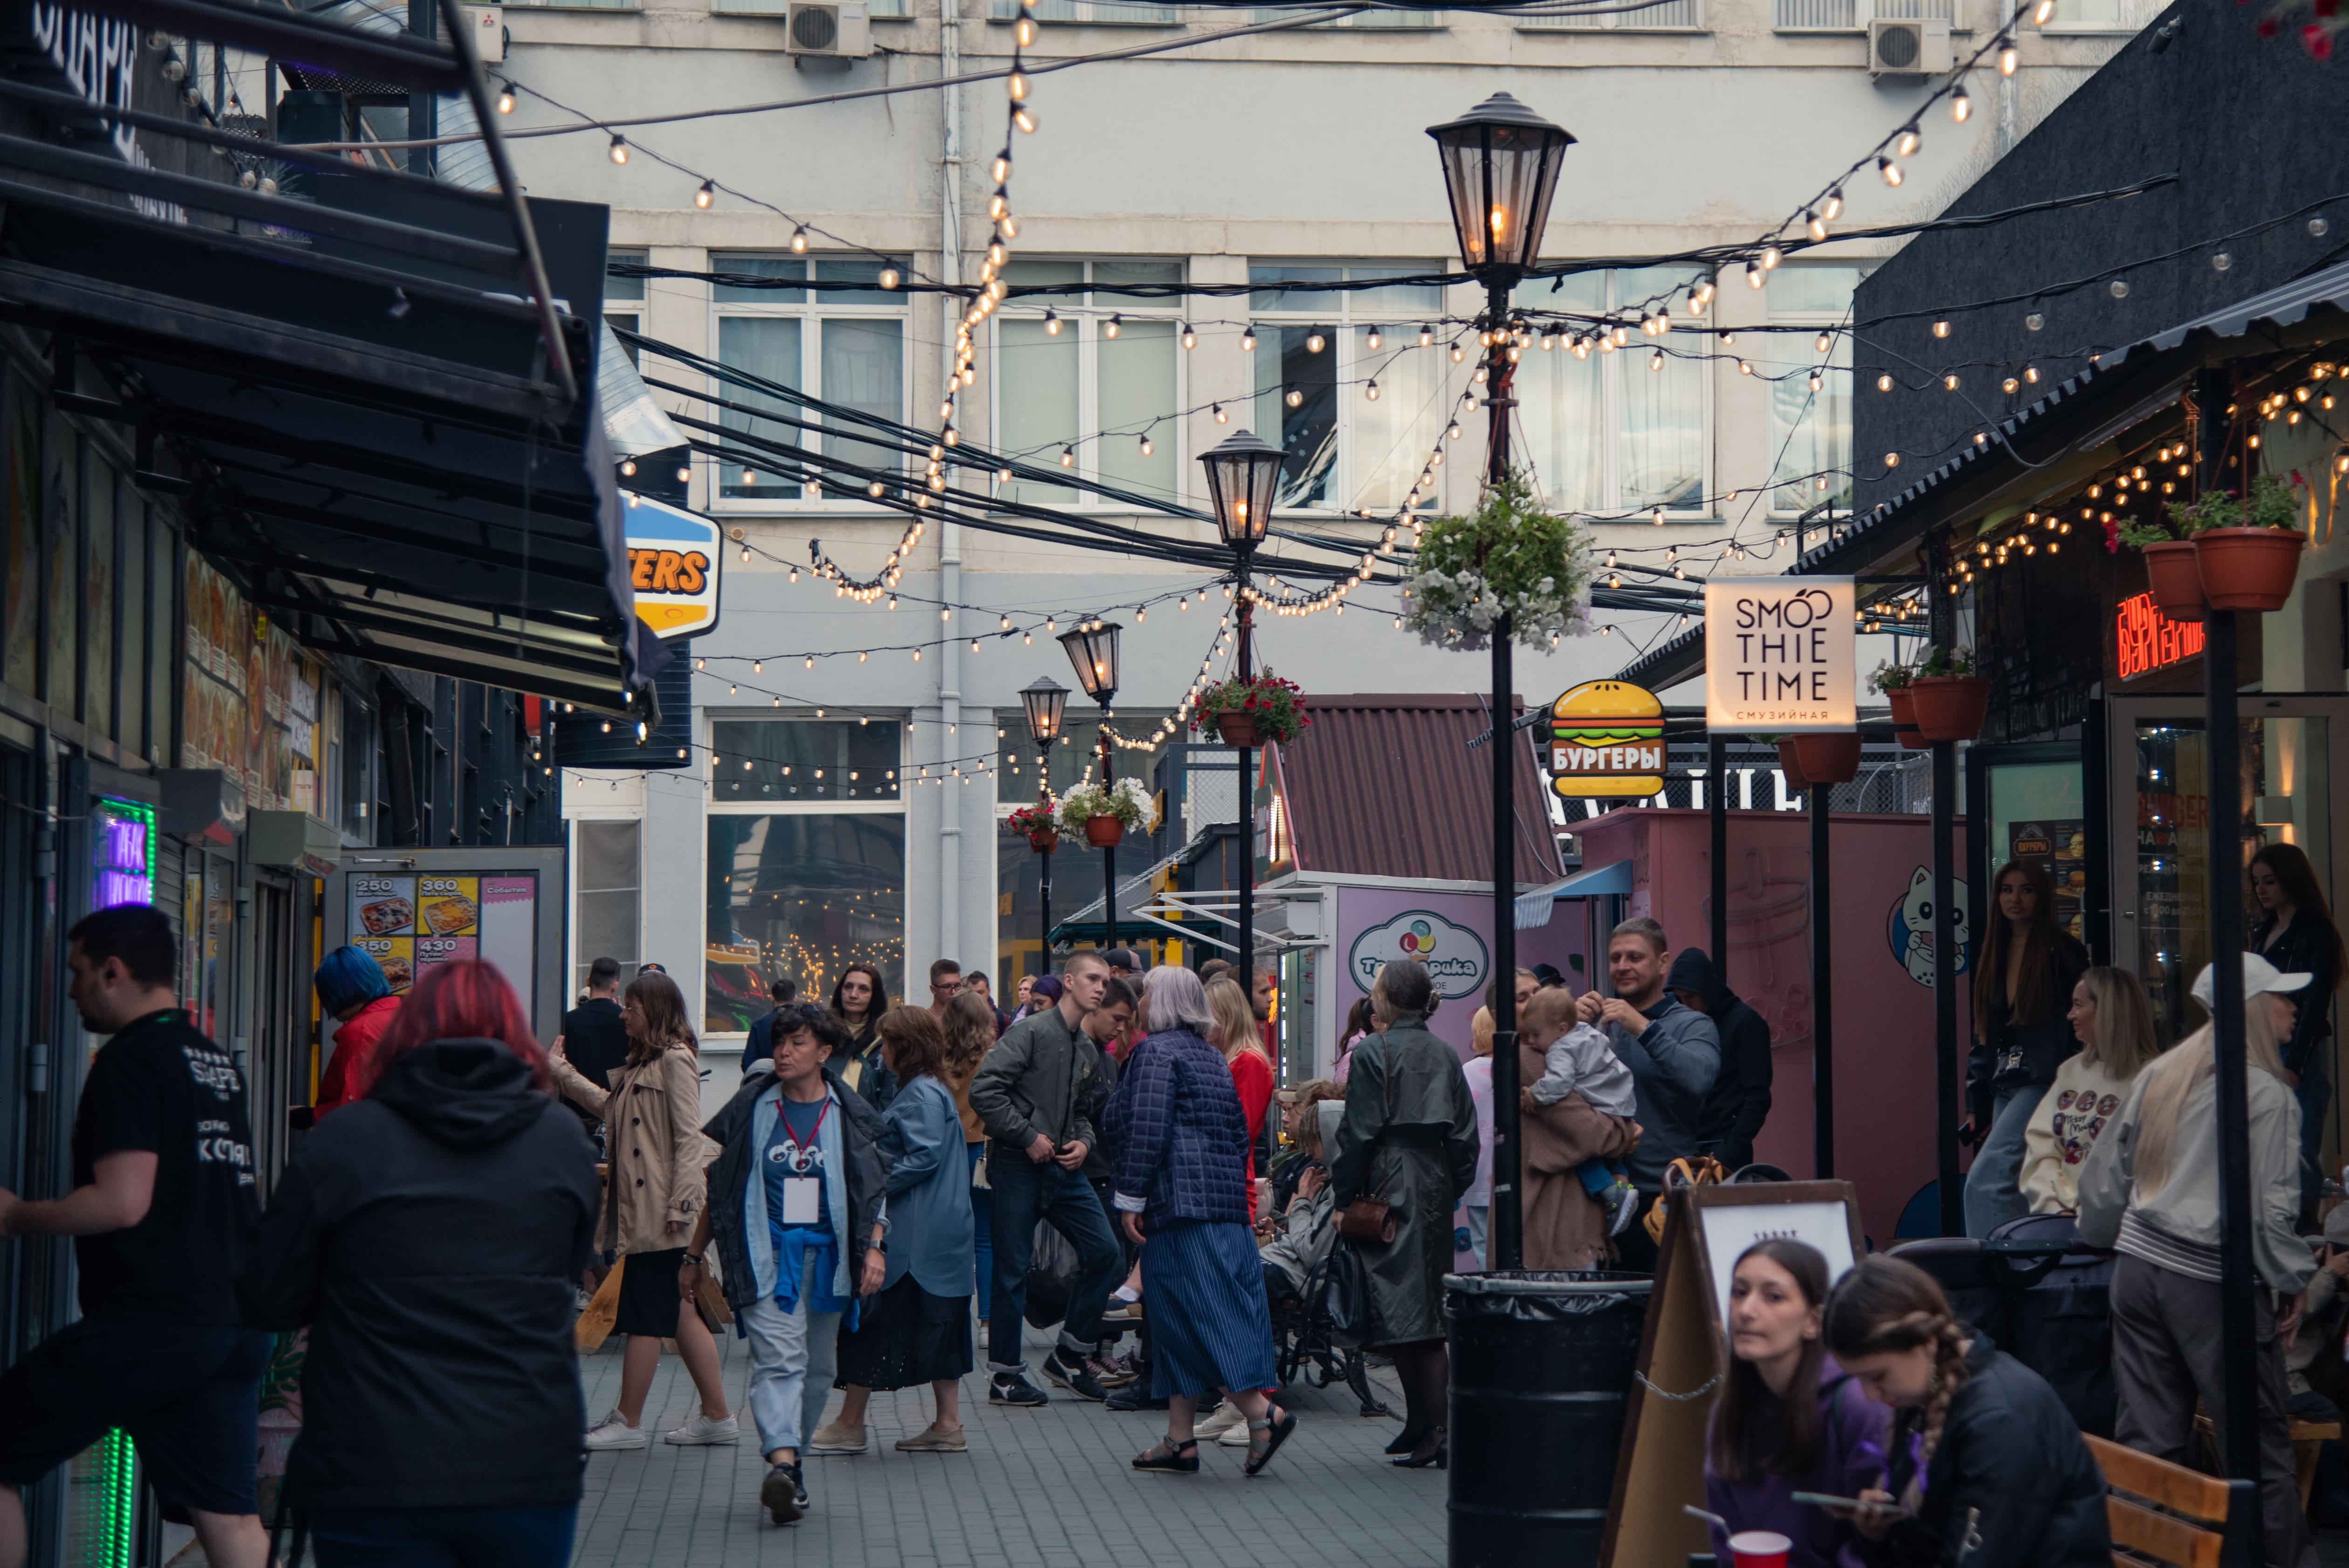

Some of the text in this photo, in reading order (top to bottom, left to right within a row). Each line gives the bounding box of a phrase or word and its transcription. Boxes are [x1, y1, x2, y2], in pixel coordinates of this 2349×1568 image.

[628, 548, 710, 595] ERS
[1737, 627, 1827, 663] THIE
[1737, 671, 1828, 701] TIME
[1736, 709, 1829, 720] СМУЗИЙНАЯ
[1553, 746, 1661, 770] БУРГЕРЫ
[356, 879, 393, 891] 250
[422, 879, 458, 892] 360
[355, 939, 393, 952] 350
[420, 940, 457, 952] 430
